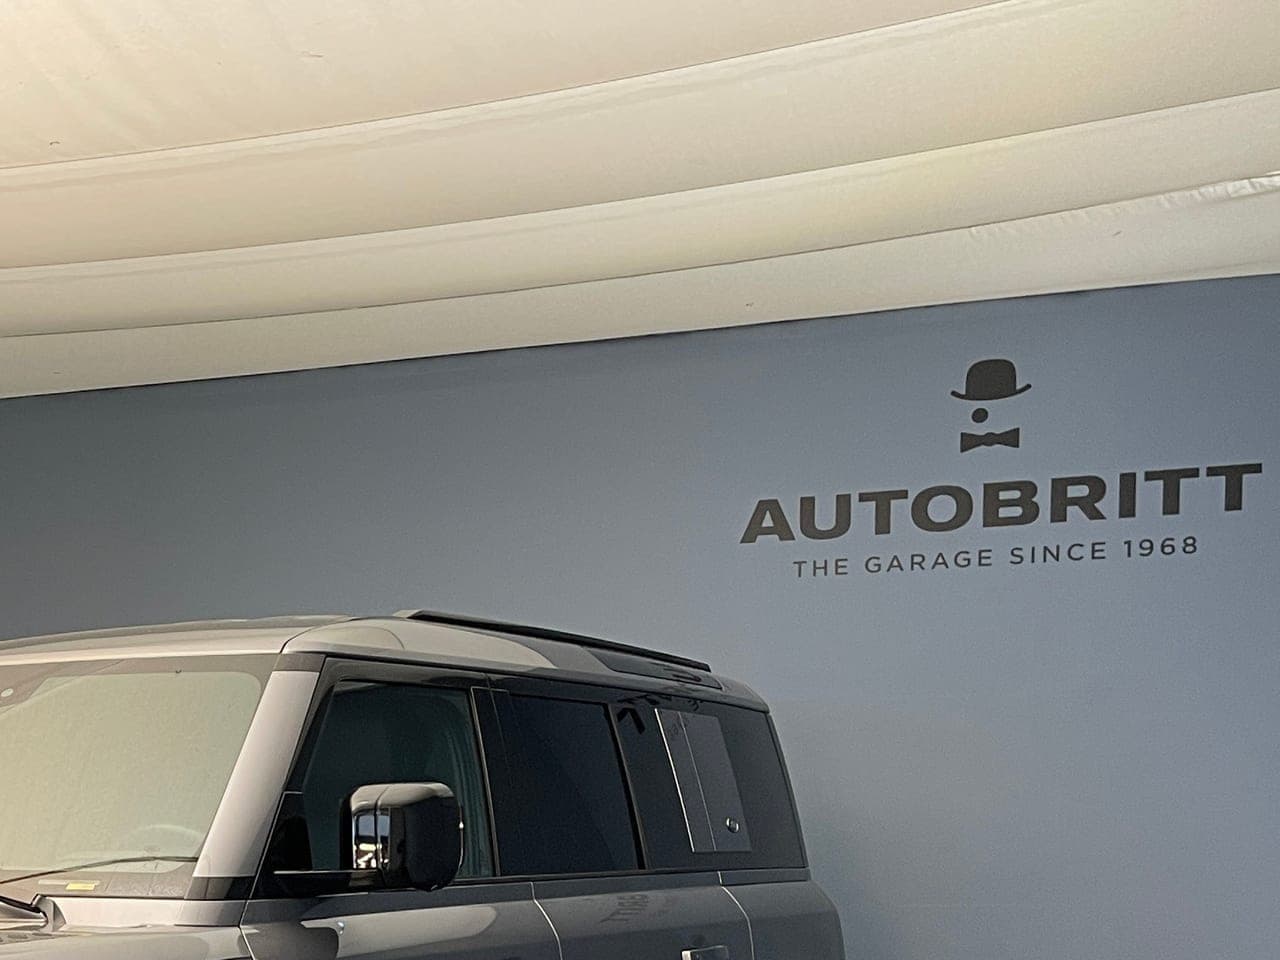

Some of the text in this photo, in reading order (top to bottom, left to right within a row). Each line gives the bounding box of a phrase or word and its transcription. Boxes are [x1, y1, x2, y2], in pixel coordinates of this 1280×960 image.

[739, 463, 1263, 544] AUTOBRITT
[794, 535, 1198, 578] THE GARAGE SINCE 1968
